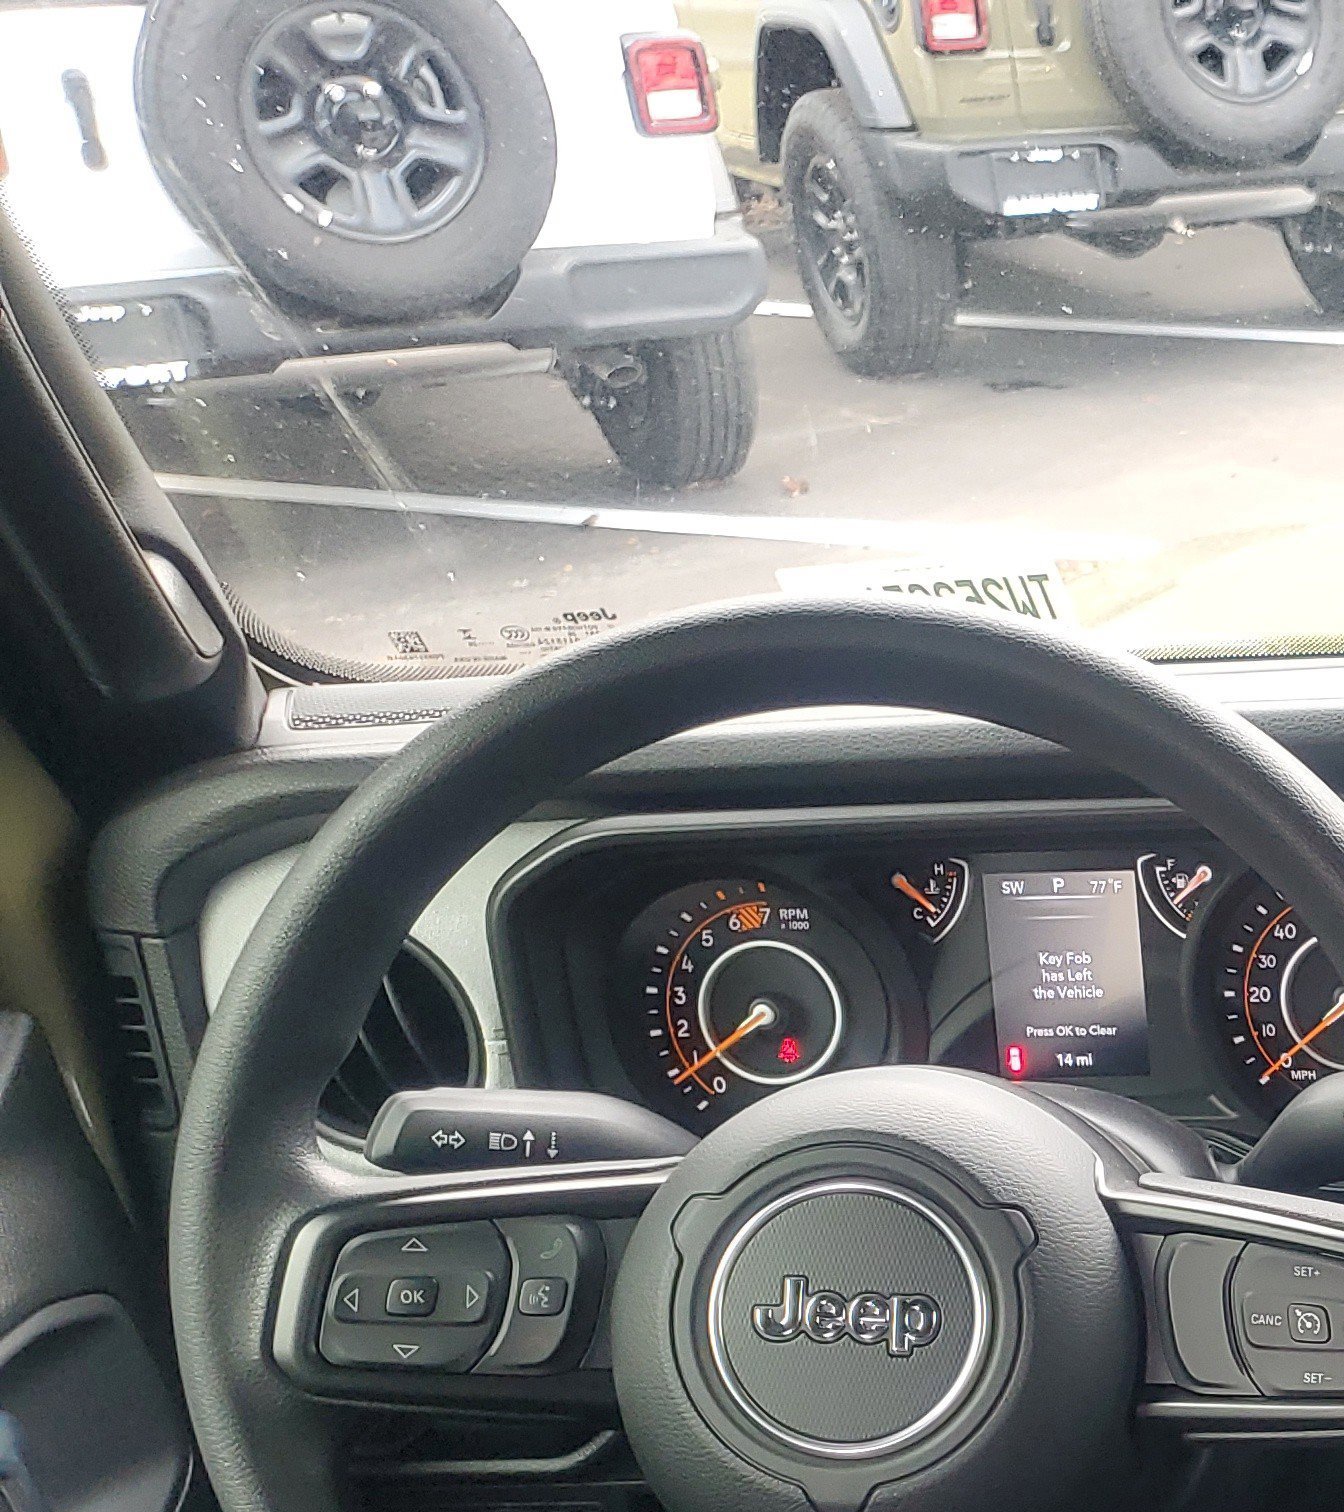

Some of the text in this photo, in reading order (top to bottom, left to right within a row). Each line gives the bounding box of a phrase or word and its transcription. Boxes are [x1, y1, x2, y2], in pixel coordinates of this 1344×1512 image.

[934, 863, 944, 875] H
[1166, 859, 1175, 870] F
[1001, 880, 1025, 895] SW
[1053, 878, 1065, 893] P
[1090, 878, 1123, 894] 77°F
[760, 908, 771, 924] 7
[779, 909, 809, 920] RPM
[913, 908, 923, 919] C
[729, 914, 740, 930] 6
[788, 921, 809, 930] 1000
[701, 930, 713, 946] 5
[1274, 923, 1296, 939] 40
[681, 955, 694, 972] 4
[1039, 952, 1091, 967] Key Fob
[1258, 955, 1276, 968] 30
[1042, 969, 1093, 982] has Left
[674, 987, 686, 1004] 3
[1034, 985, 1104, 999] the Vehicle
[1250, 987, 1271, 1002] 20
[677, 1020, 690, 1037] 2
[1026, 1026, 1117, 1038] Press OK to Clear
[1262, 1024, 1275, 1036] 10
[1057, 1053, 1073, 1067] 14
[1291, 1071, 1316, 1080] MPH
[713, 1077, 726, 1093] 0
[1294, 1266, 1321, 1278] SET+
[401, 1290, 425, 1304] OK
[752, 1275, 942, 1357] Jeep
[1251, 1314, 1282, 1326] CANC
